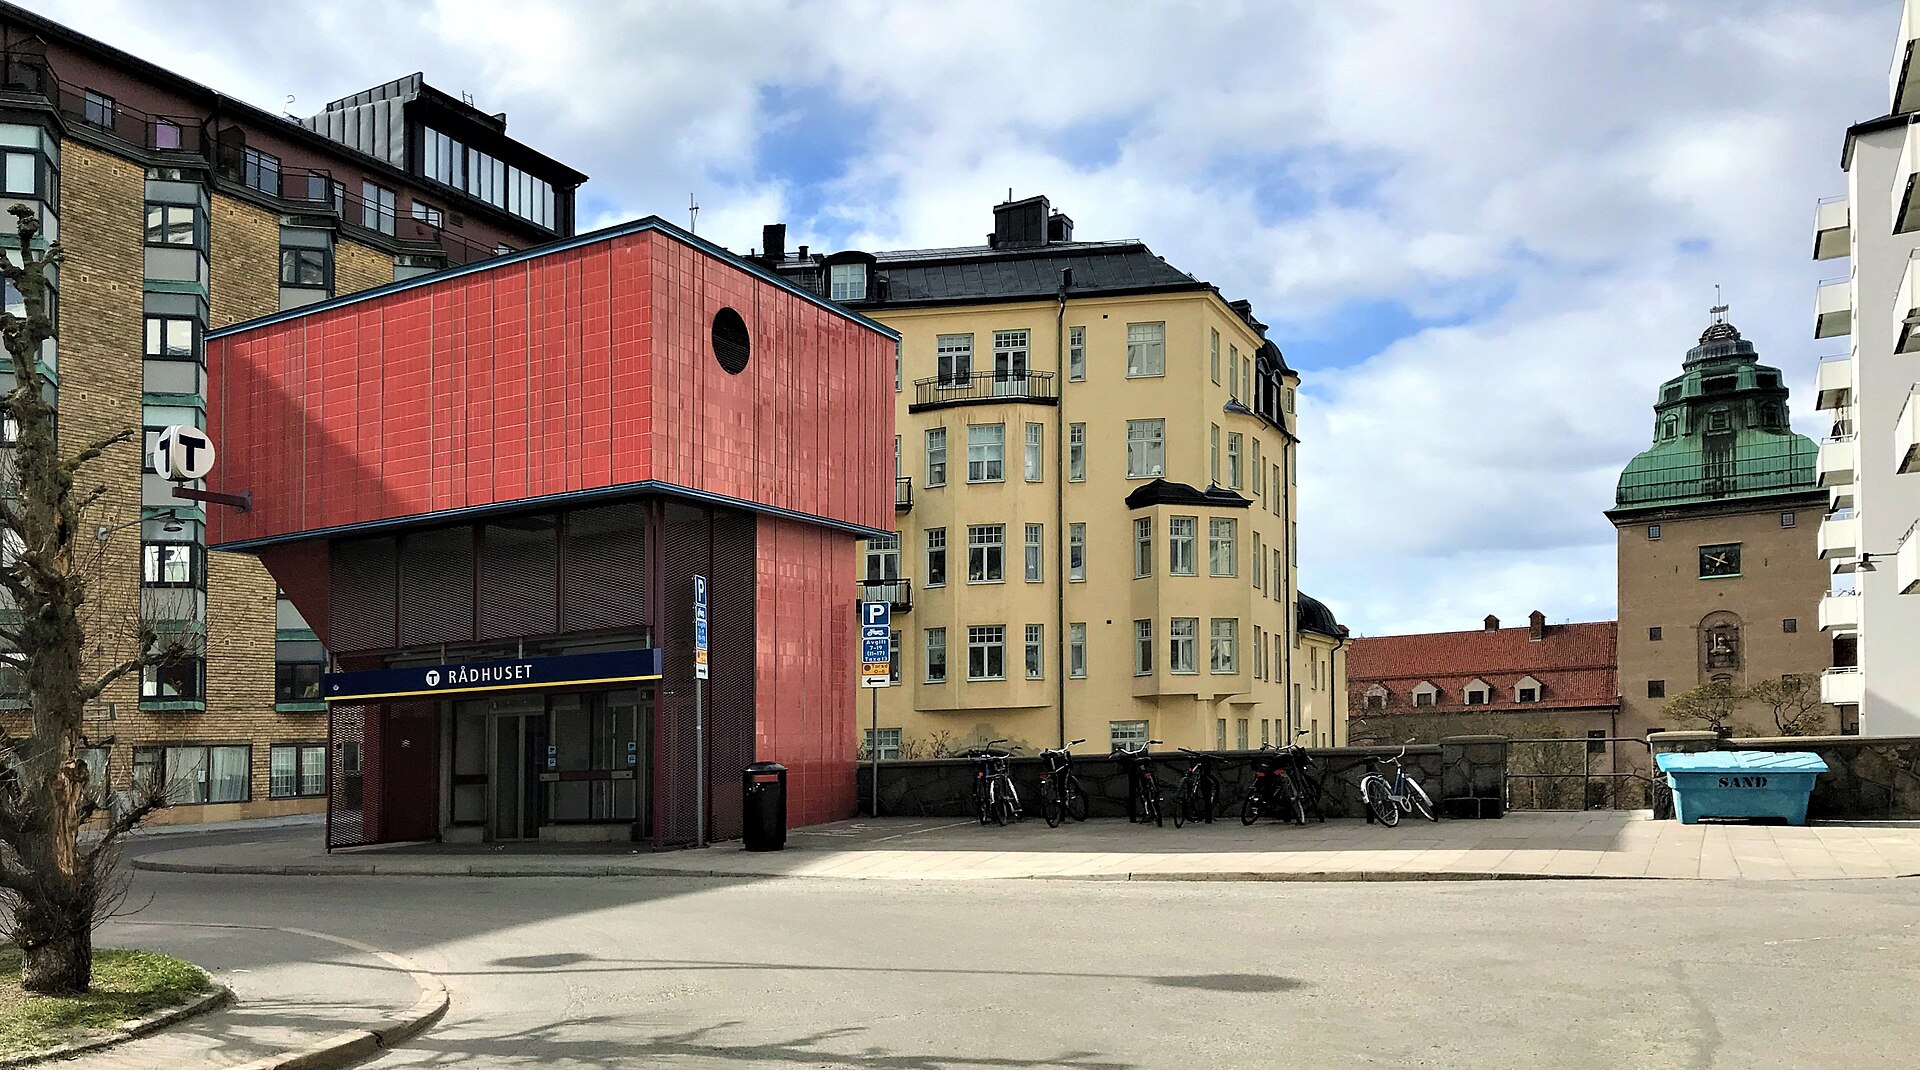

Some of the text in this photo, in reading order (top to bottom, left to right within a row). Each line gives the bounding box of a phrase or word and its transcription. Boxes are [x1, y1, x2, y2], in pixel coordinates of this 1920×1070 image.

[179, 434, 206, 472] T
[698, 579, 705, 602] P
[869, 604, 885, 624] P
[448, 664, 533, 684] RÅDHUSET
[1718, 775, 1768, 788] SAND
